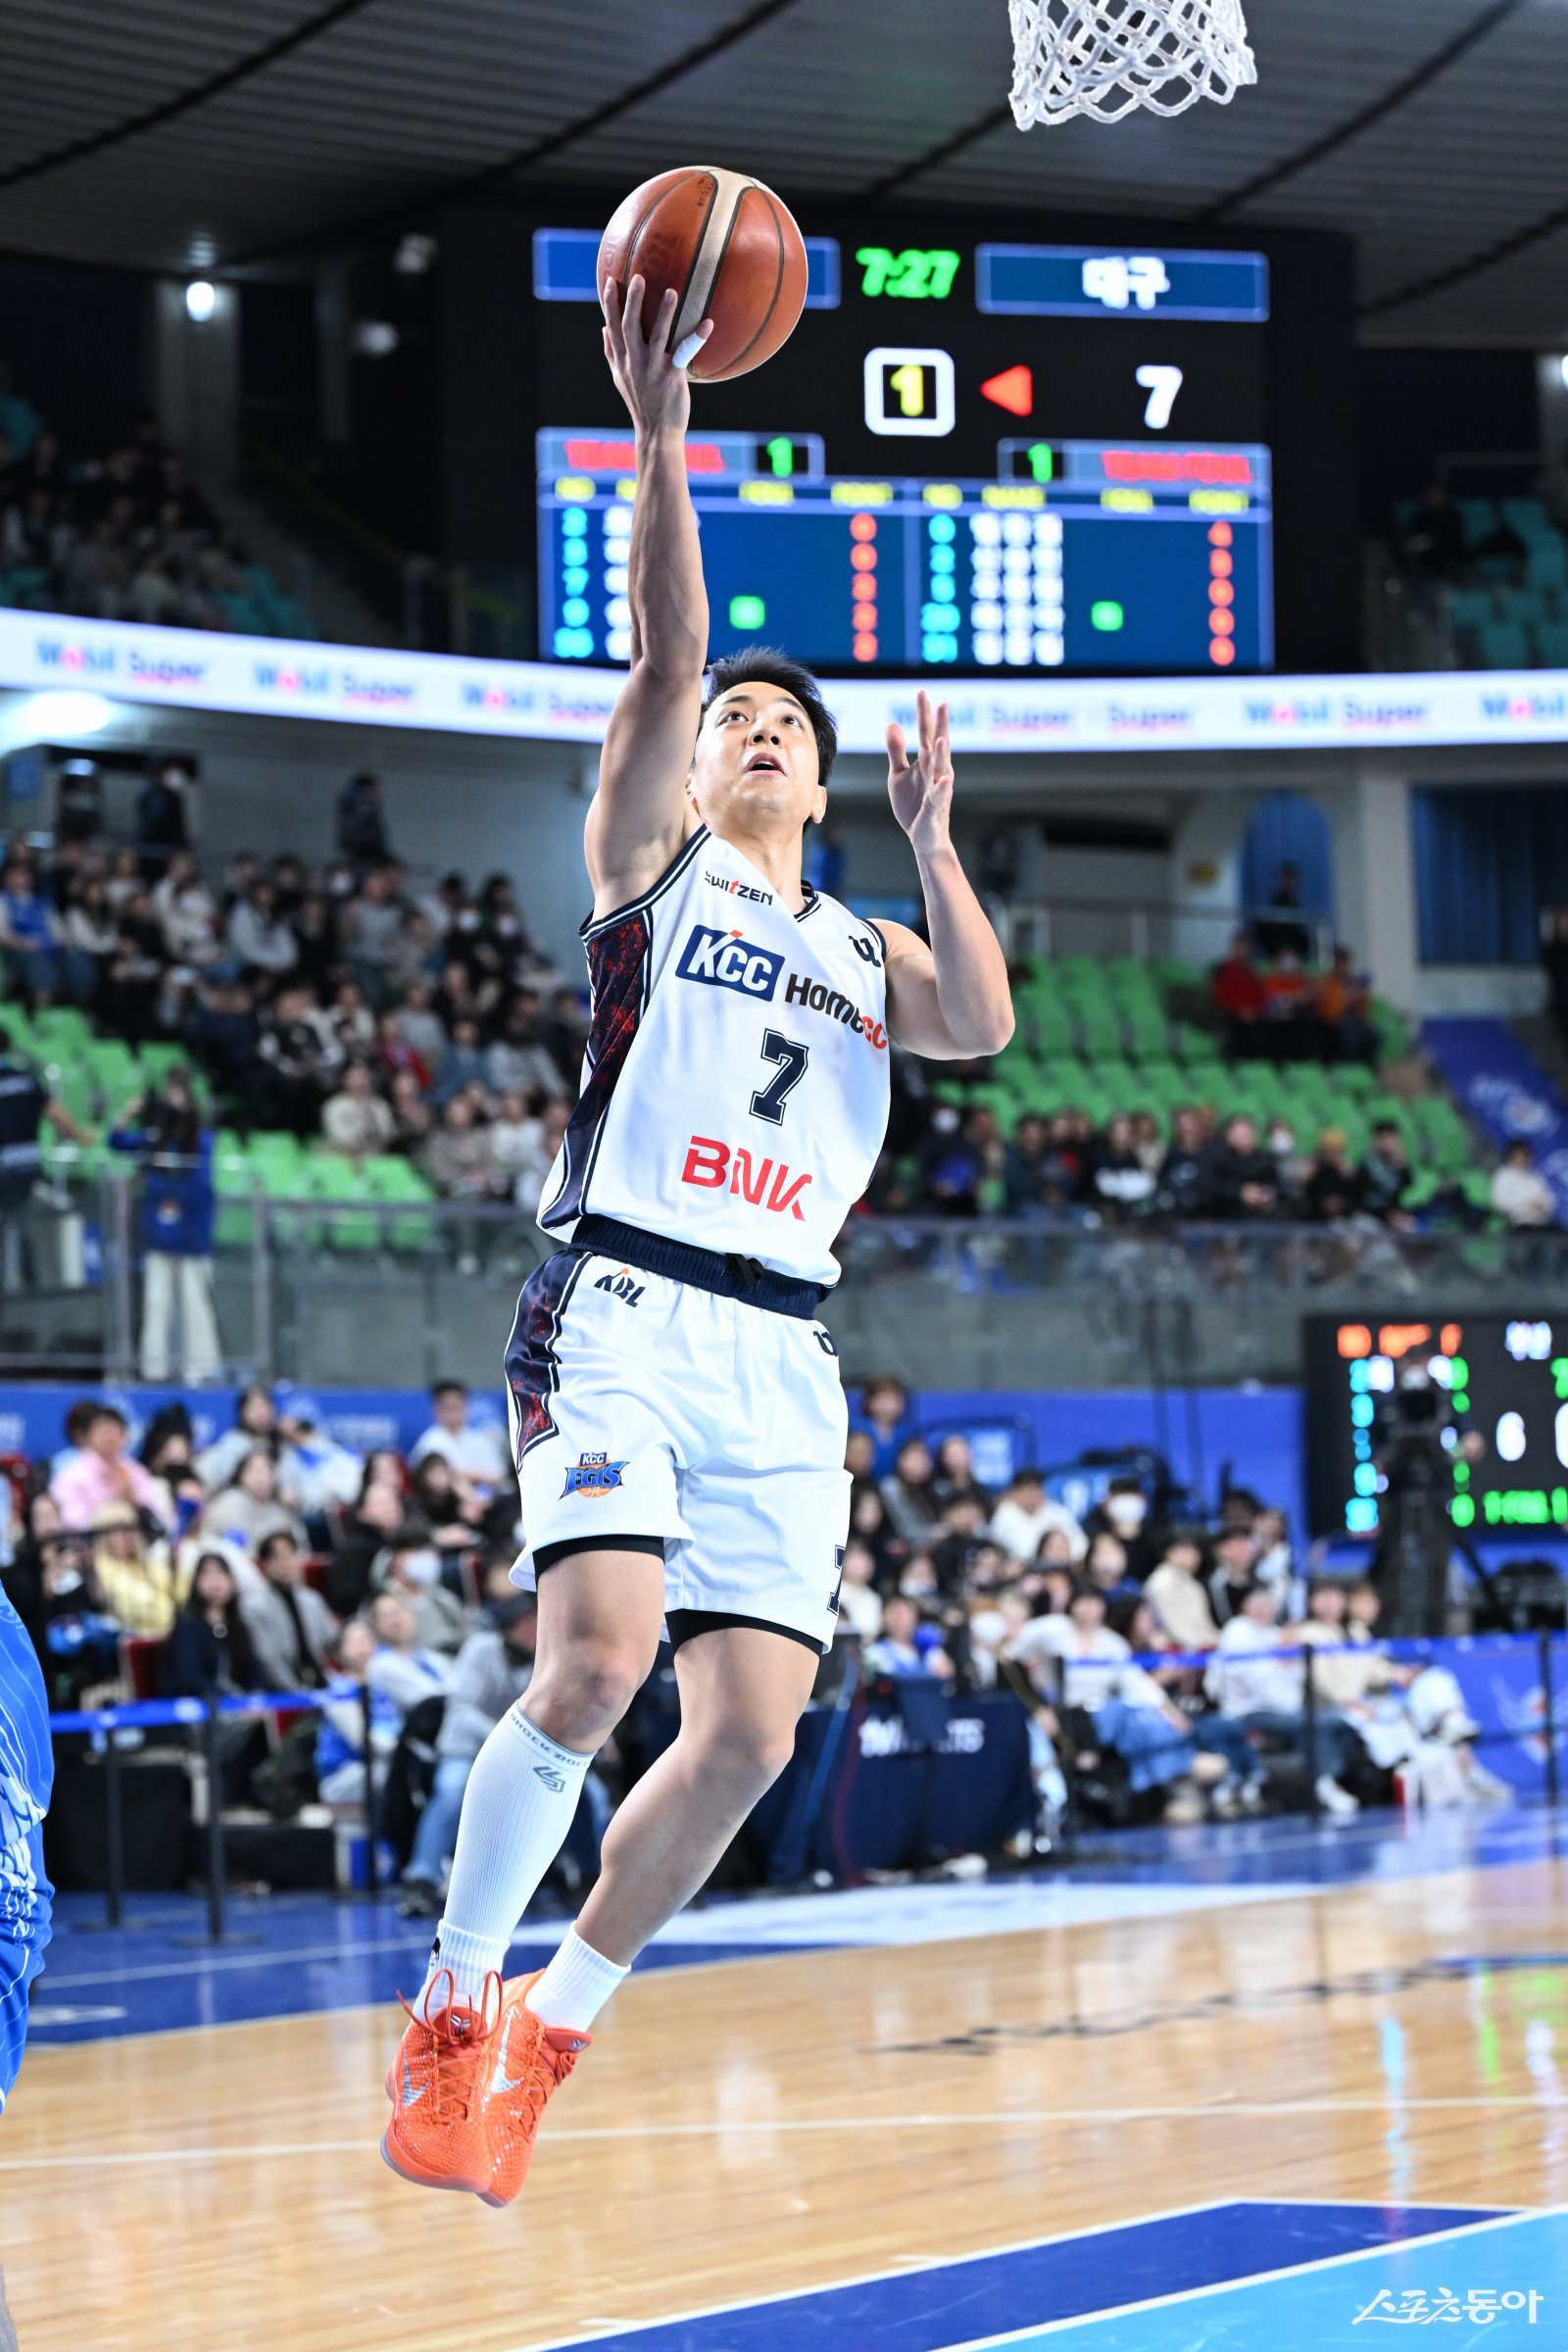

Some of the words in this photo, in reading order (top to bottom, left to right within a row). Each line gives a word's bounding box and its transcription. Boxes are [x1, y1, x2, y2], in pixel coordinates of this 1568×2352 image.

[857, 248, 960, 299] 7:27
[891, 365, 924, 417] 1
[1136, 366, 1183, 429] 7
[687, 930, 771, 993] KCC
[750, 1028, 808, 1126] 7
[681, 1135, 812, 1221] BNK
[559, 1461, 630, 1500] EGIS
[582, 1452, 605, 1465] KCC
